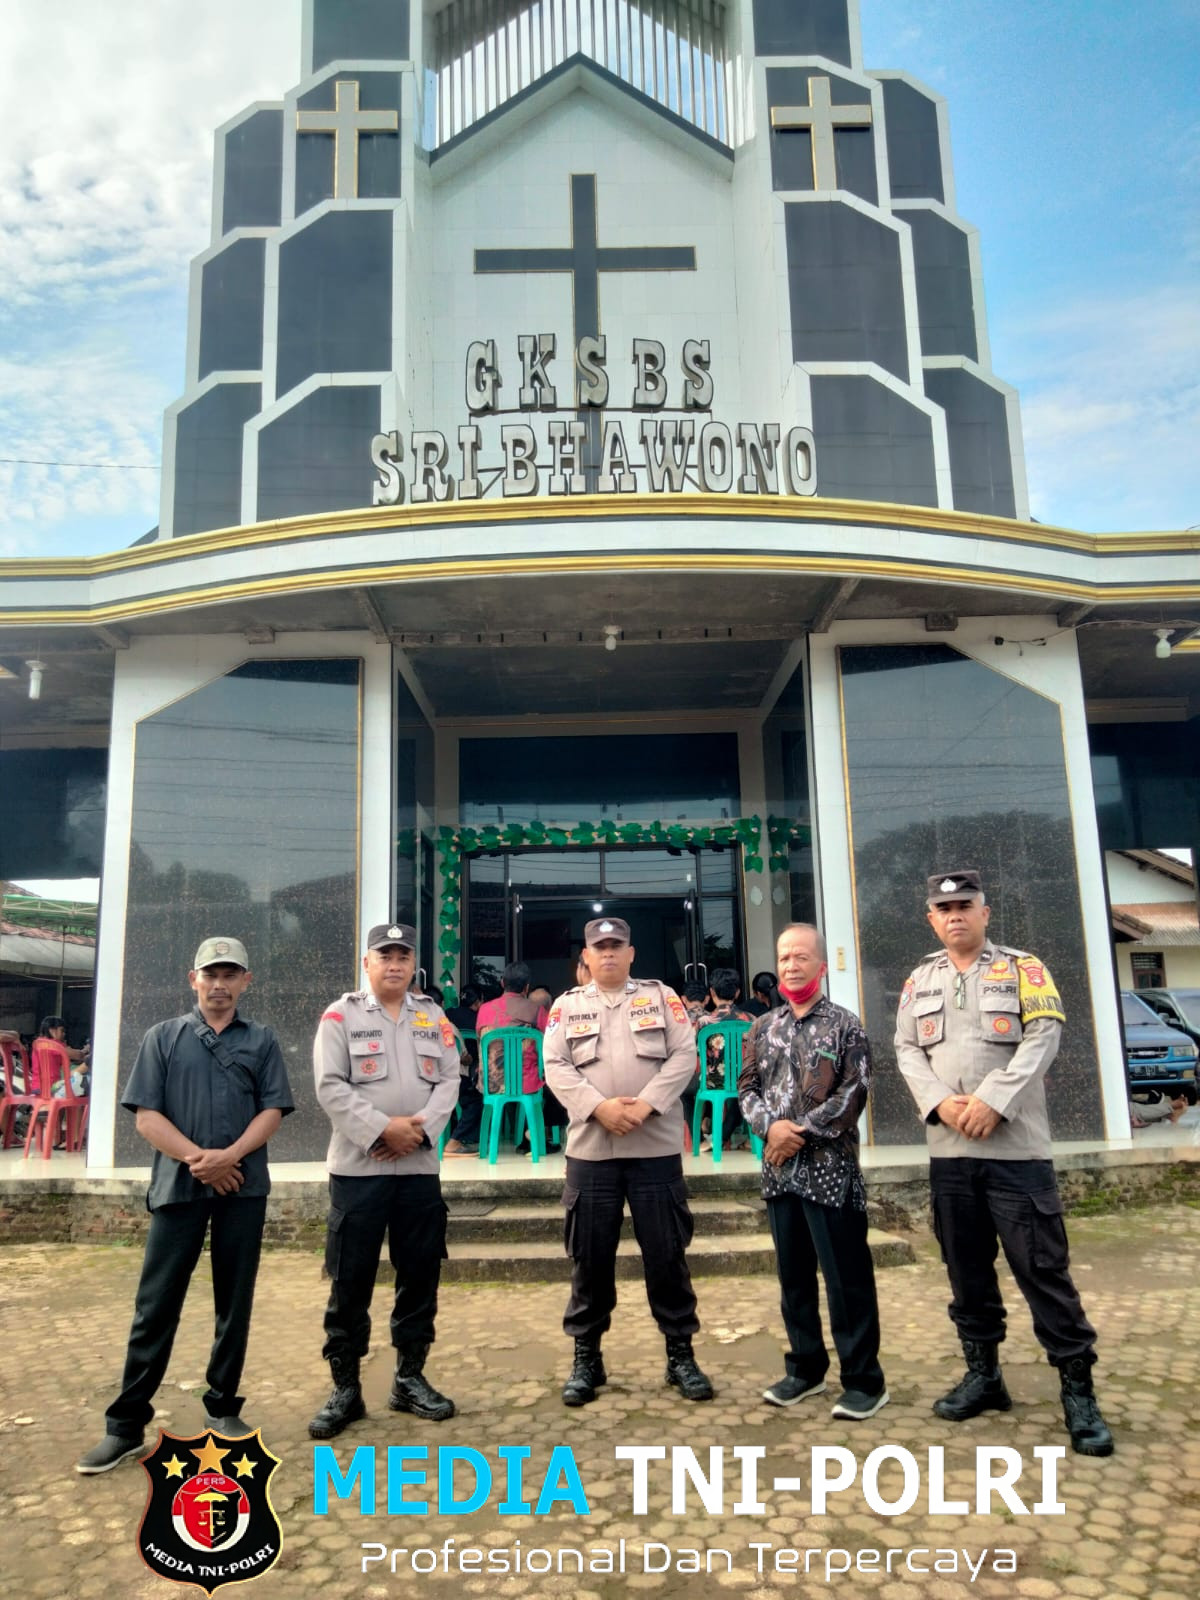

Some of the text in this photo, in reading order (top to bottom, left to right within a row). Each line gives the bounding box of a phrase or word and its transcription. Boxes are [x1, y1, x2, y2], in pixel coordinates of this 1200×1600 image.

[466, 333, 714, 416] GKSBS
[983, 985, 1017, 995] POLRI
[630, 1005, 659, 1019] POLRI
[412, 1030, 439, 1041] POLRI
